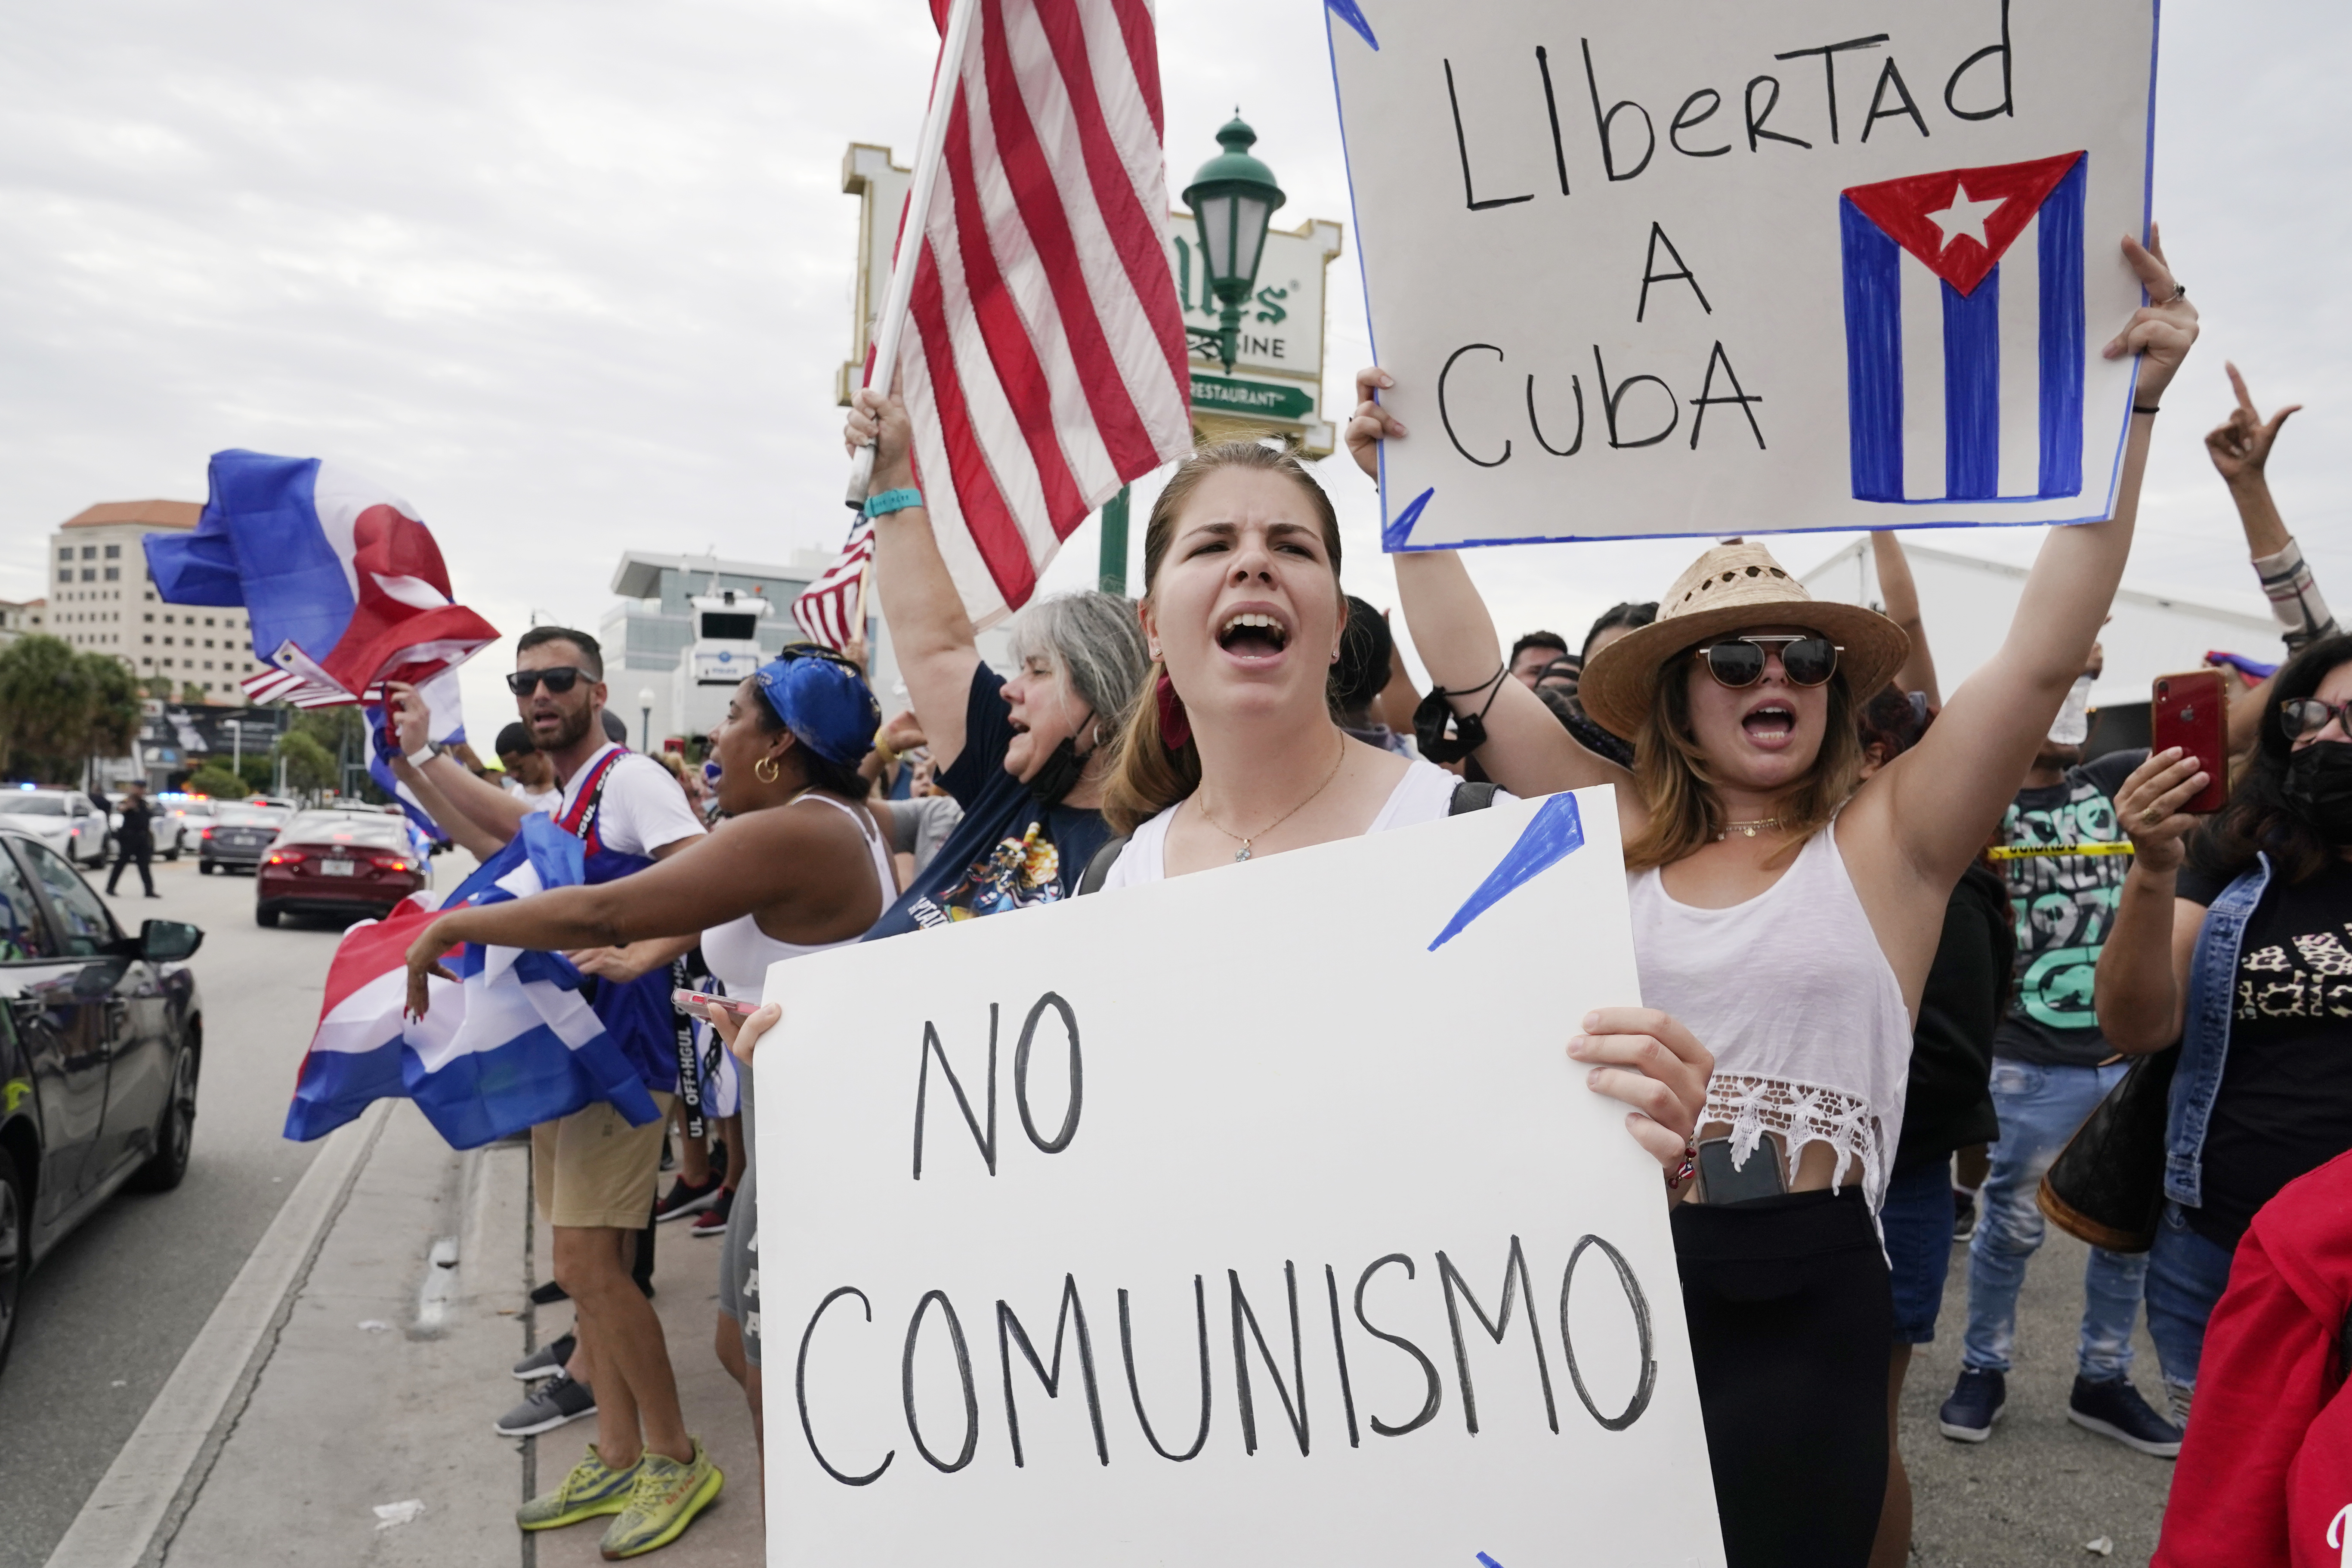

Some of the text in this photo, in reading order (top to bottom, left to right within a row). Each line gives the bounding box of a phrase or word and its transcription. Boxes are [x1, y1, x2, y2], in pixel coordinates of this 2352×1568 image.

[1636, 221, 1712, 323] A
[913, 991, 1083, 1181] NO
[795, 1234, 1657, 1487] COMUNISMO
